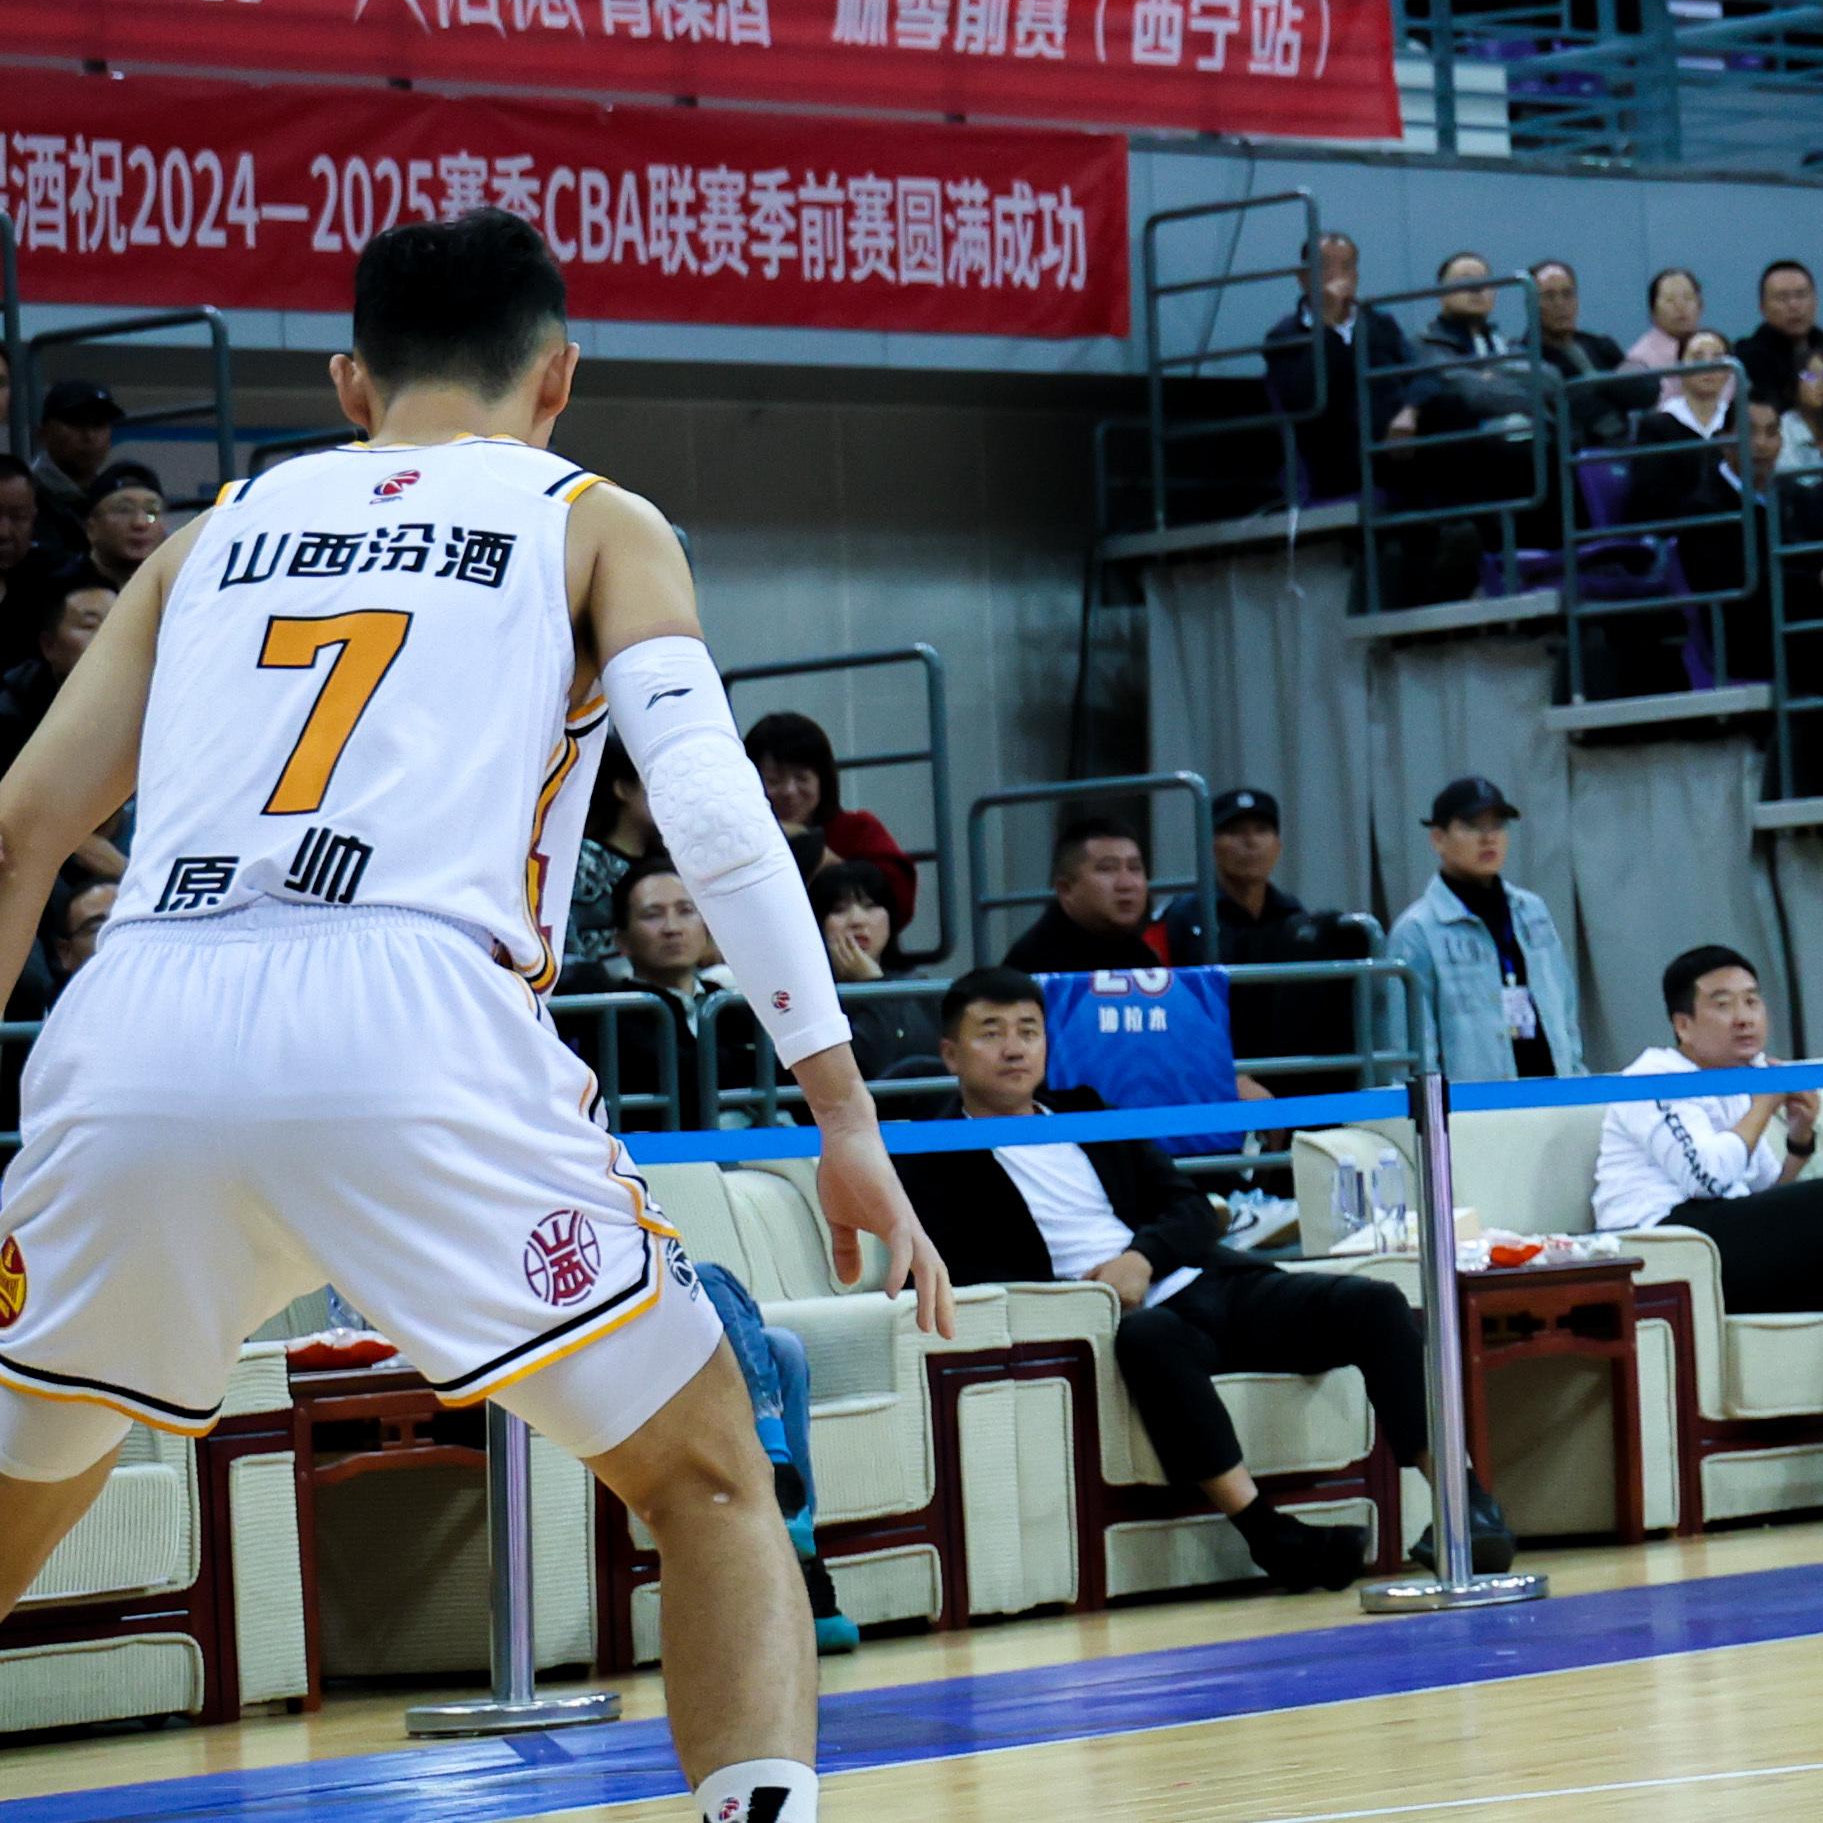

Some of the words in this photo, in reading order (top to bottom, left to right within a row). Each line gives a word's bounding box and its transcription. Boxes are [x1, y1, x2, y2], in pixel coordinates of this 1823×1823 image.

[0, 132, 1087, 290] 酒祝2024—2025赛季CBA联赛季前赛圆满成功
[218, 524, 518, 591] 山西汾酒
[258, 609, 413, 816] 7
